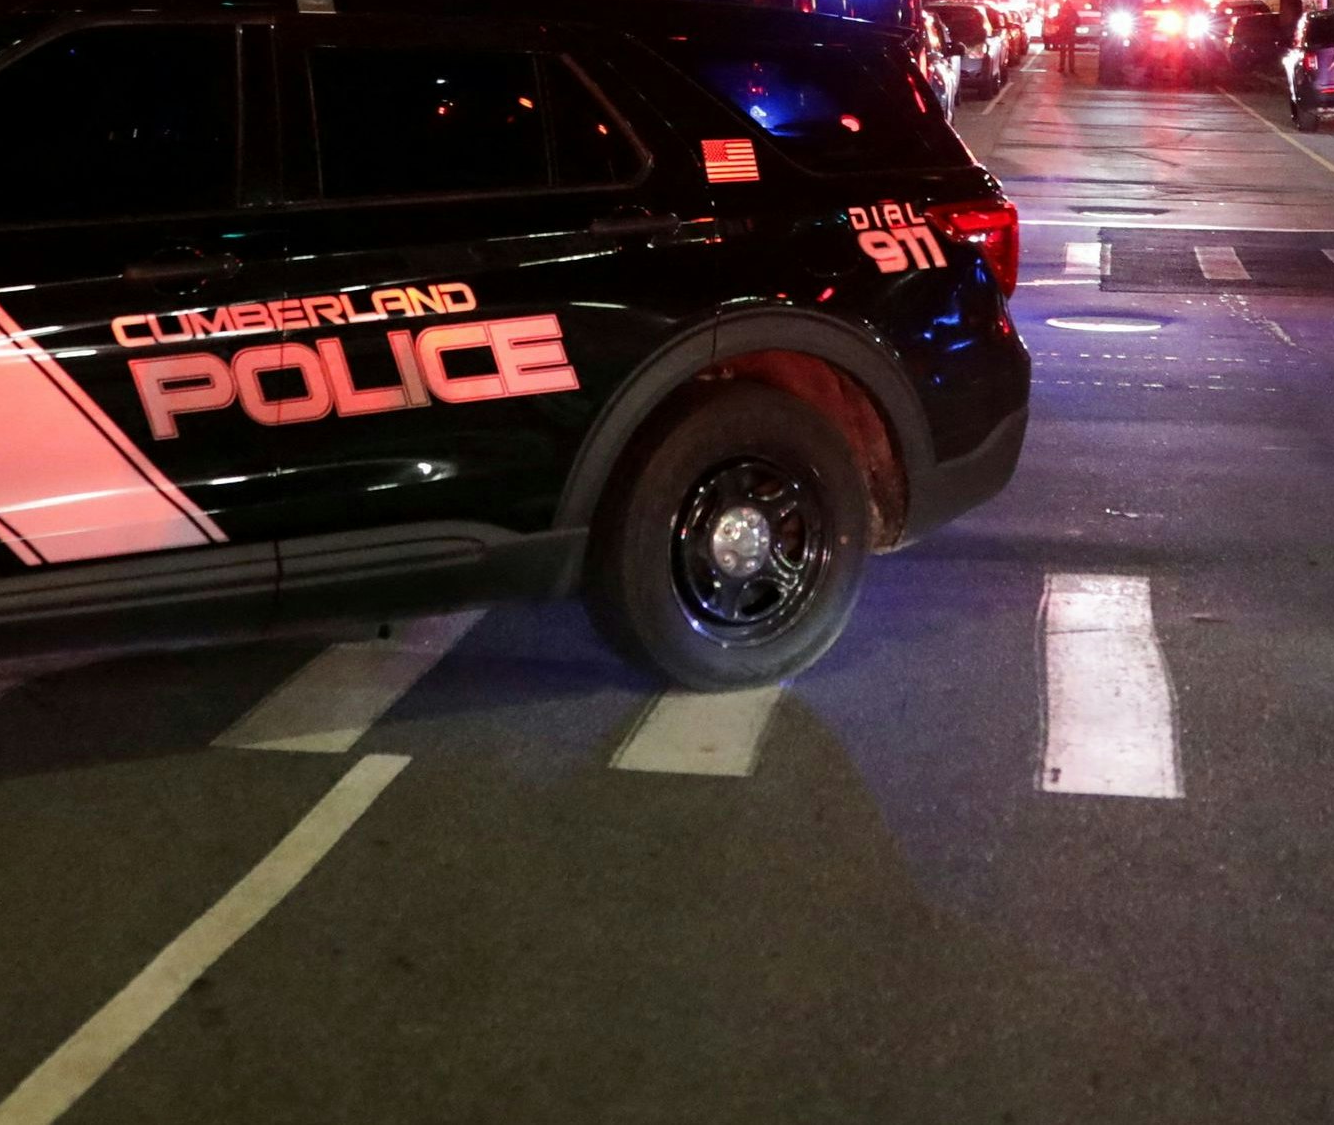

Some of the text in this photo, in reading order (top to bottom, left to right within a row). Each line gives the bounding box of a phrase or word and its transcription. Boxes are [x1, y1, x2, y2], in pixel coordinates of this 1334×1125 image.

[848, 202, 926, 230] DIAL
[858, 225, 948, 273] 911
[111, 282, 478, 348] CUMBERLAND
[127, 313, 581, 441] POLICE
